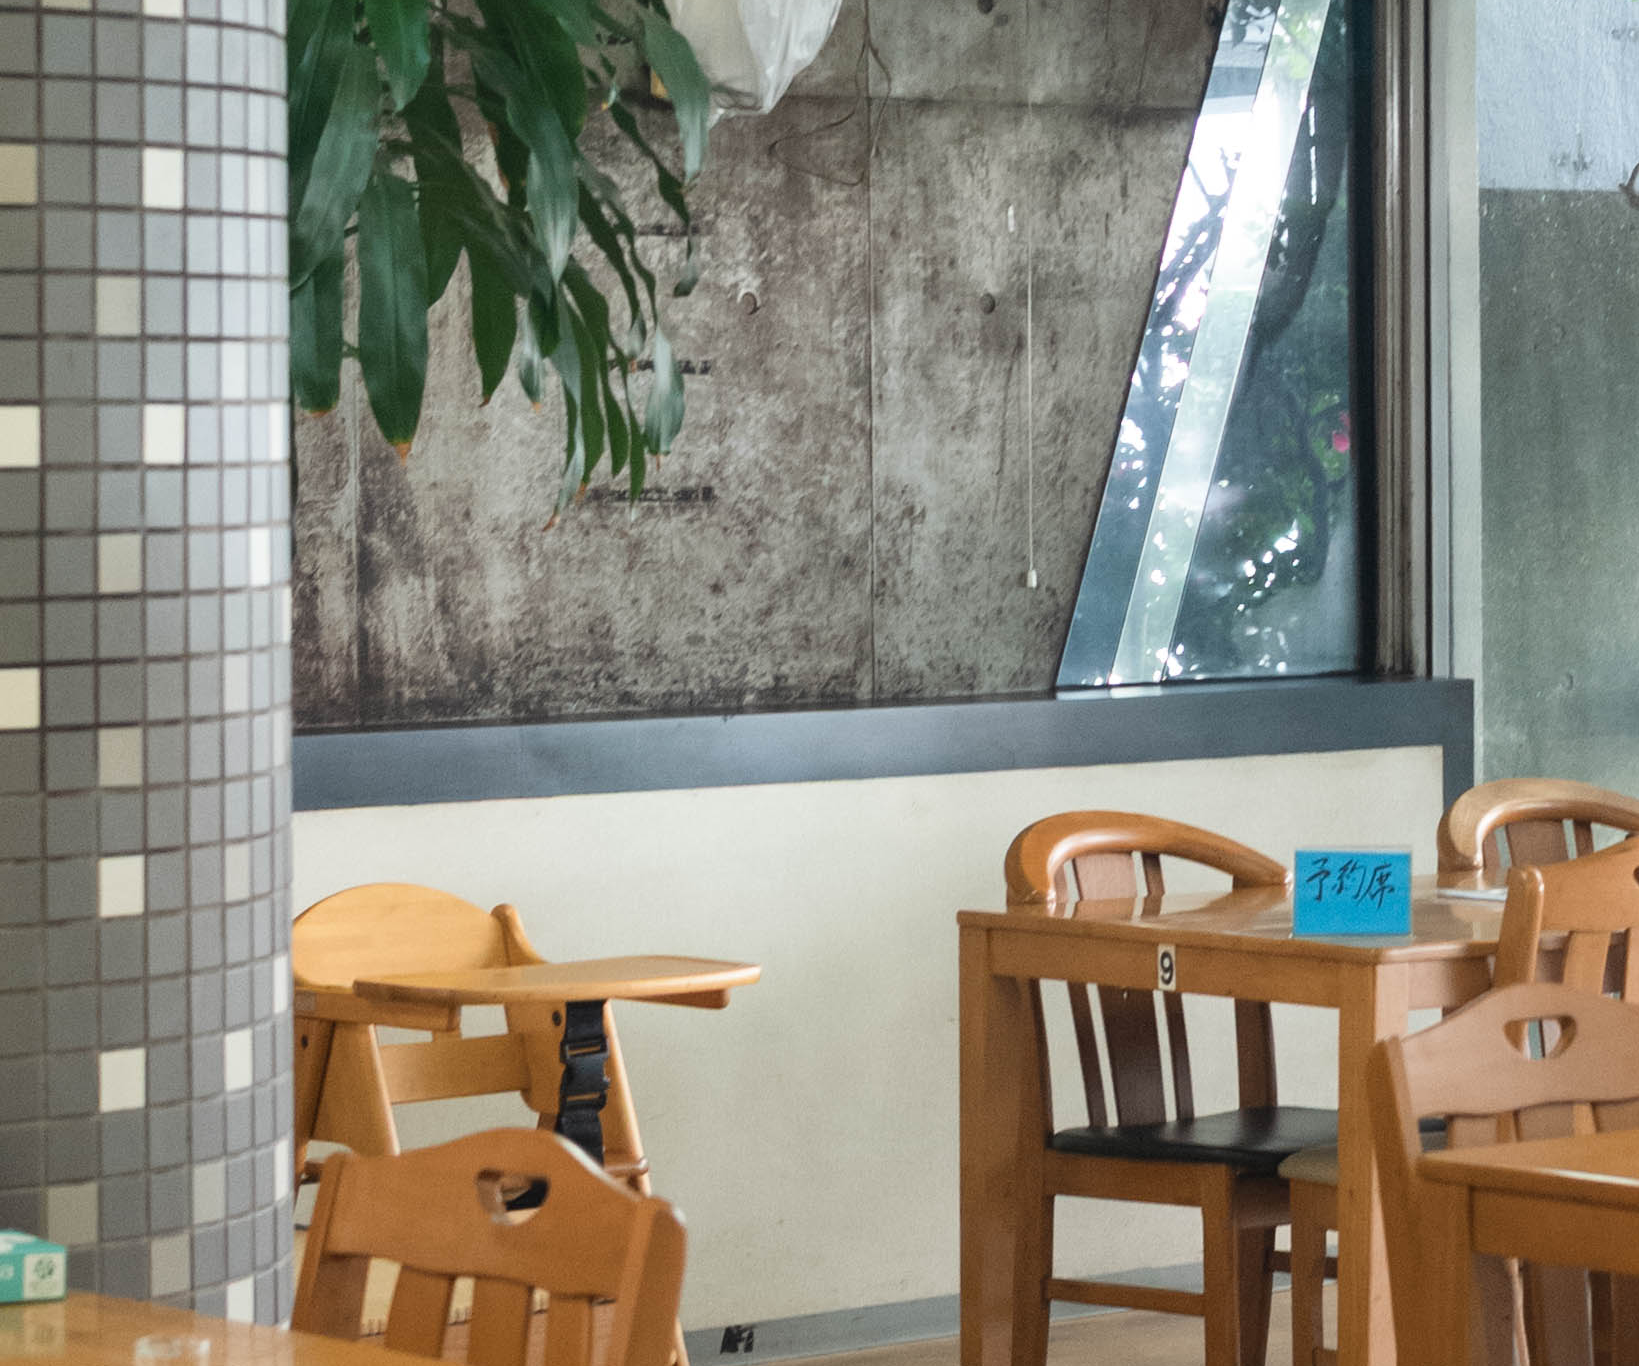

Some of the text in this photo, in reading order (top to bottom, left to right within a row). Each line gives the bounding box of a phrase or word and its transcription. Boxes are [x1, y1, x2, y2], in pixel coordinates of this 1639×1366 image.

[1306, 857, 1396, 910] 予約席
[1160, 951, 1174, 986] 9
